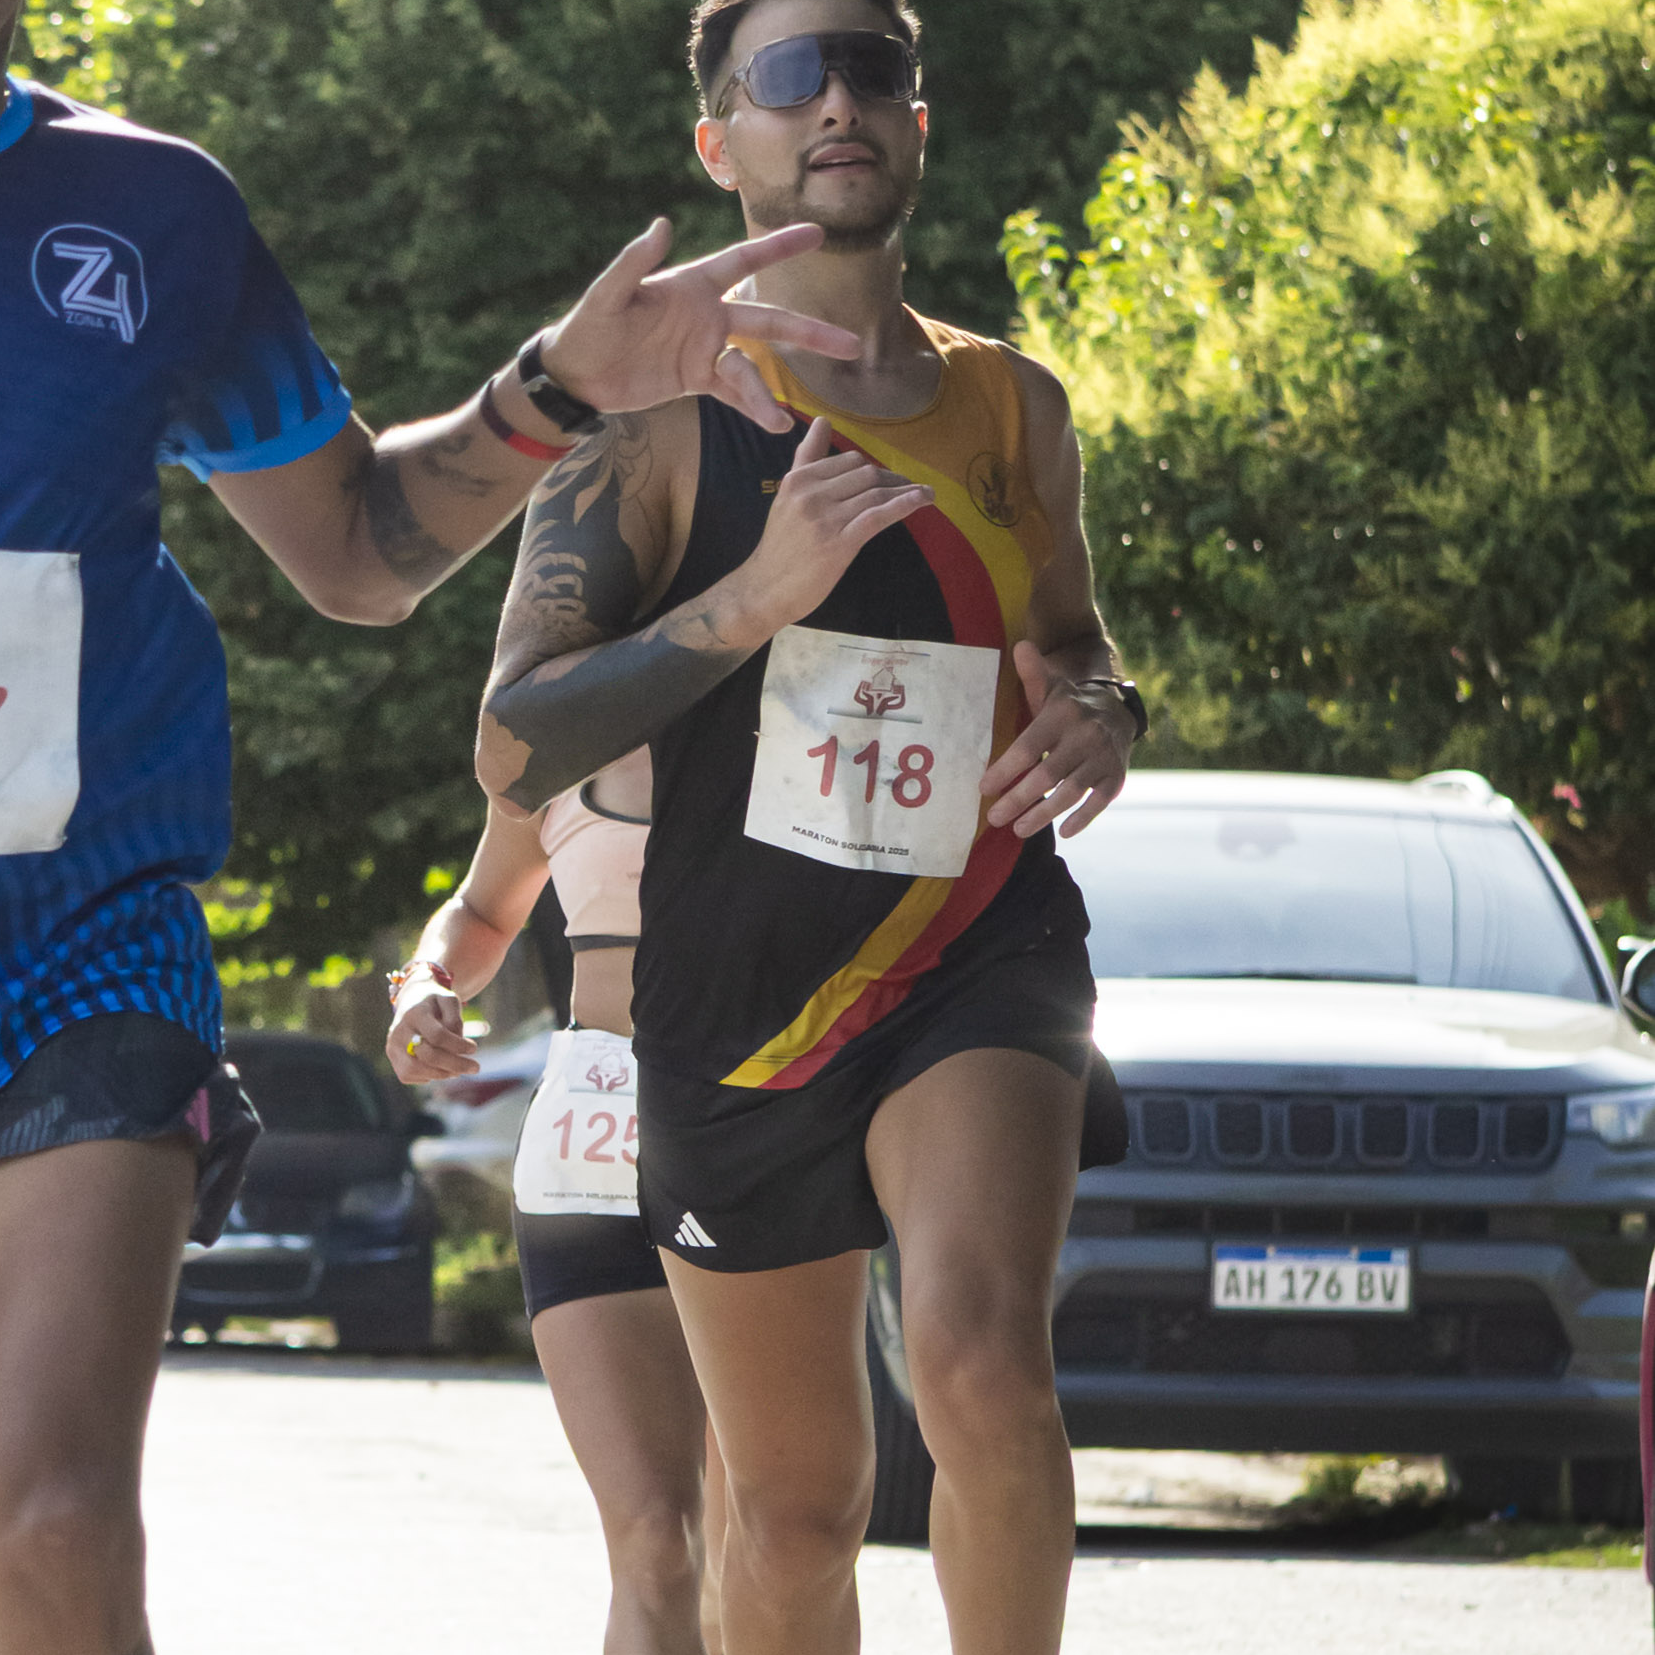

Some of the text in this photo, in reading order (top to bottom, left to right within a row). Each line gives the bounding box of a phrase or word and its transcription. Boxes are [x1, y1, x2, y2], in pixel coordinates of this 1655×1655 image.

[807, 735, 934, 809] 118
[792, 826, 839, 847] MARATON
[887, 846, 910, 856] 2025
[1224, 1267, 1400, 1302] AH 176 BV
